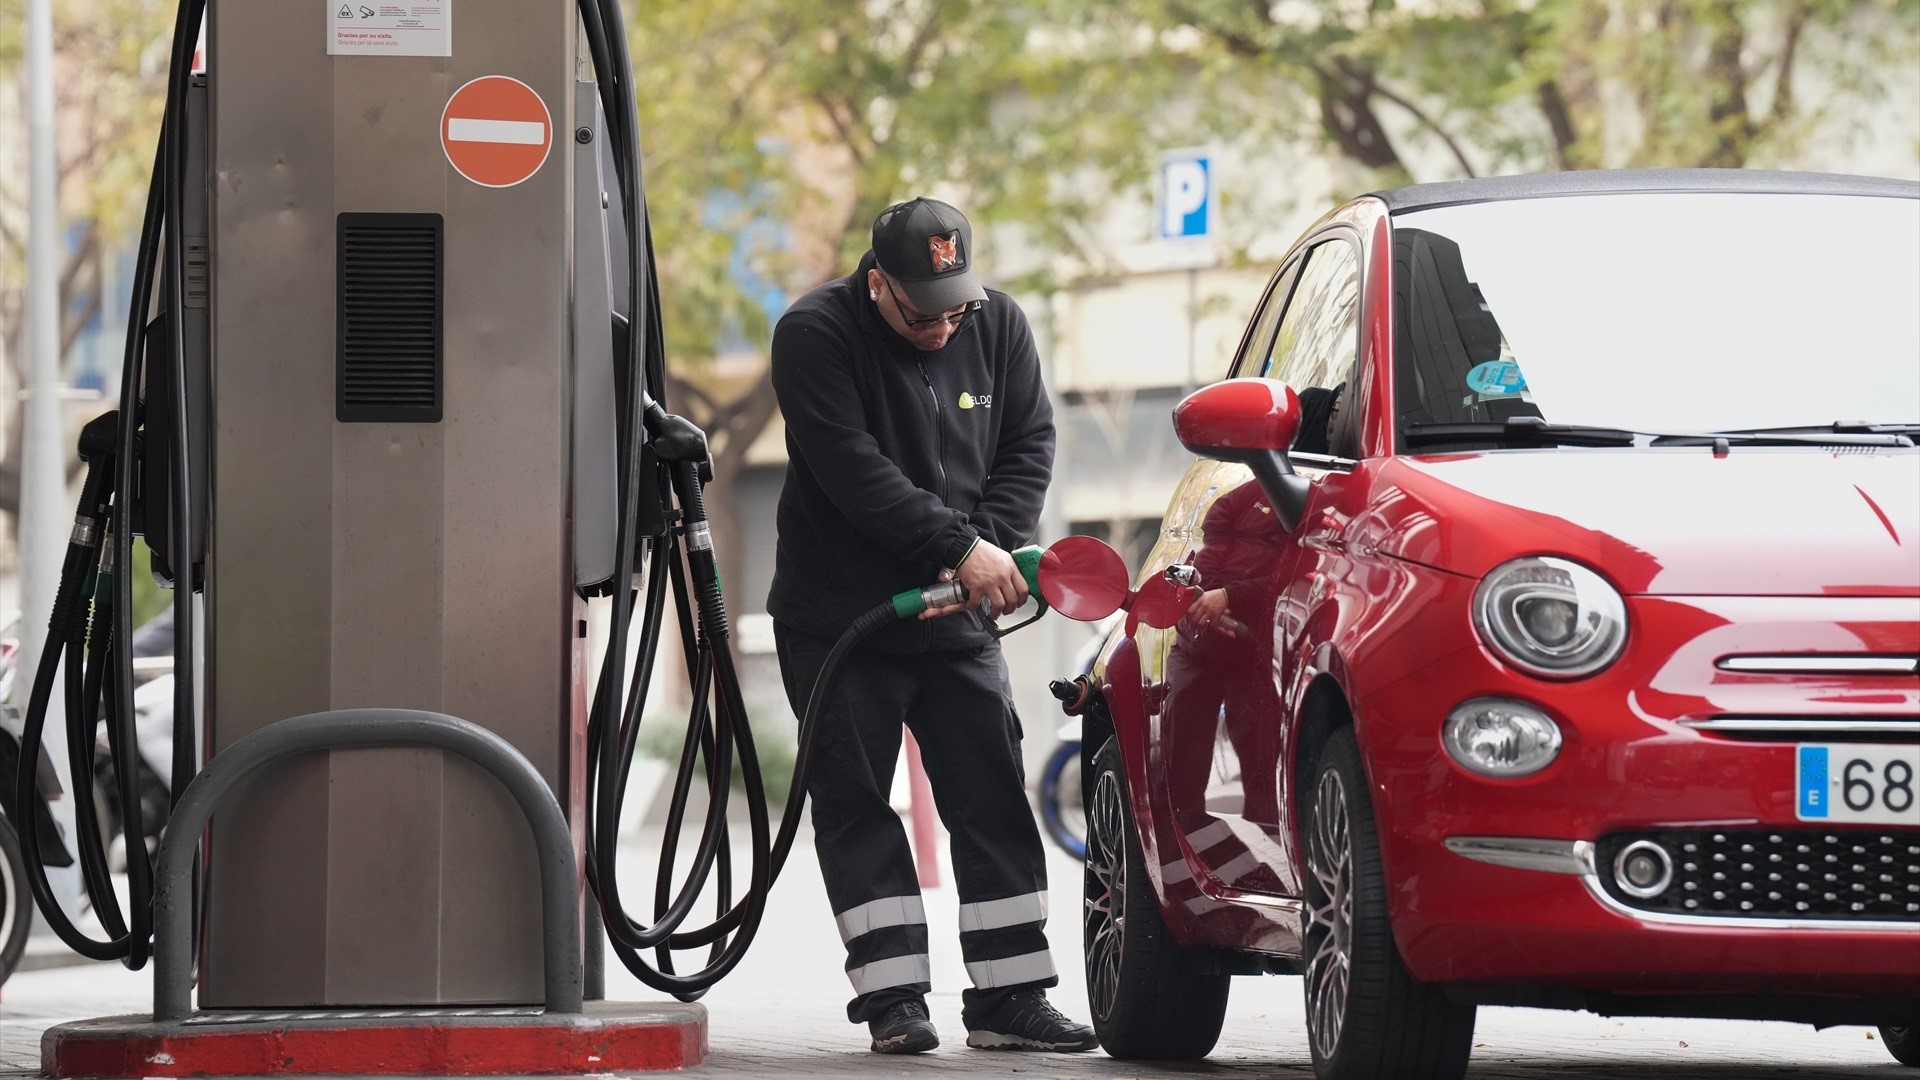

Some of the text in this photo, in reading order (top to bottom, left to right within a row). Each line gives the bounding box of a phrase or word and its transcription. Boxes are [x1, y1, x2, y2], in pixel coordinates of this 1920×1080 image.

[1167, 163, 1205, 235] P
[1808, 789, 1819, 806] E
[1842, 758, 1914, 813] 68
